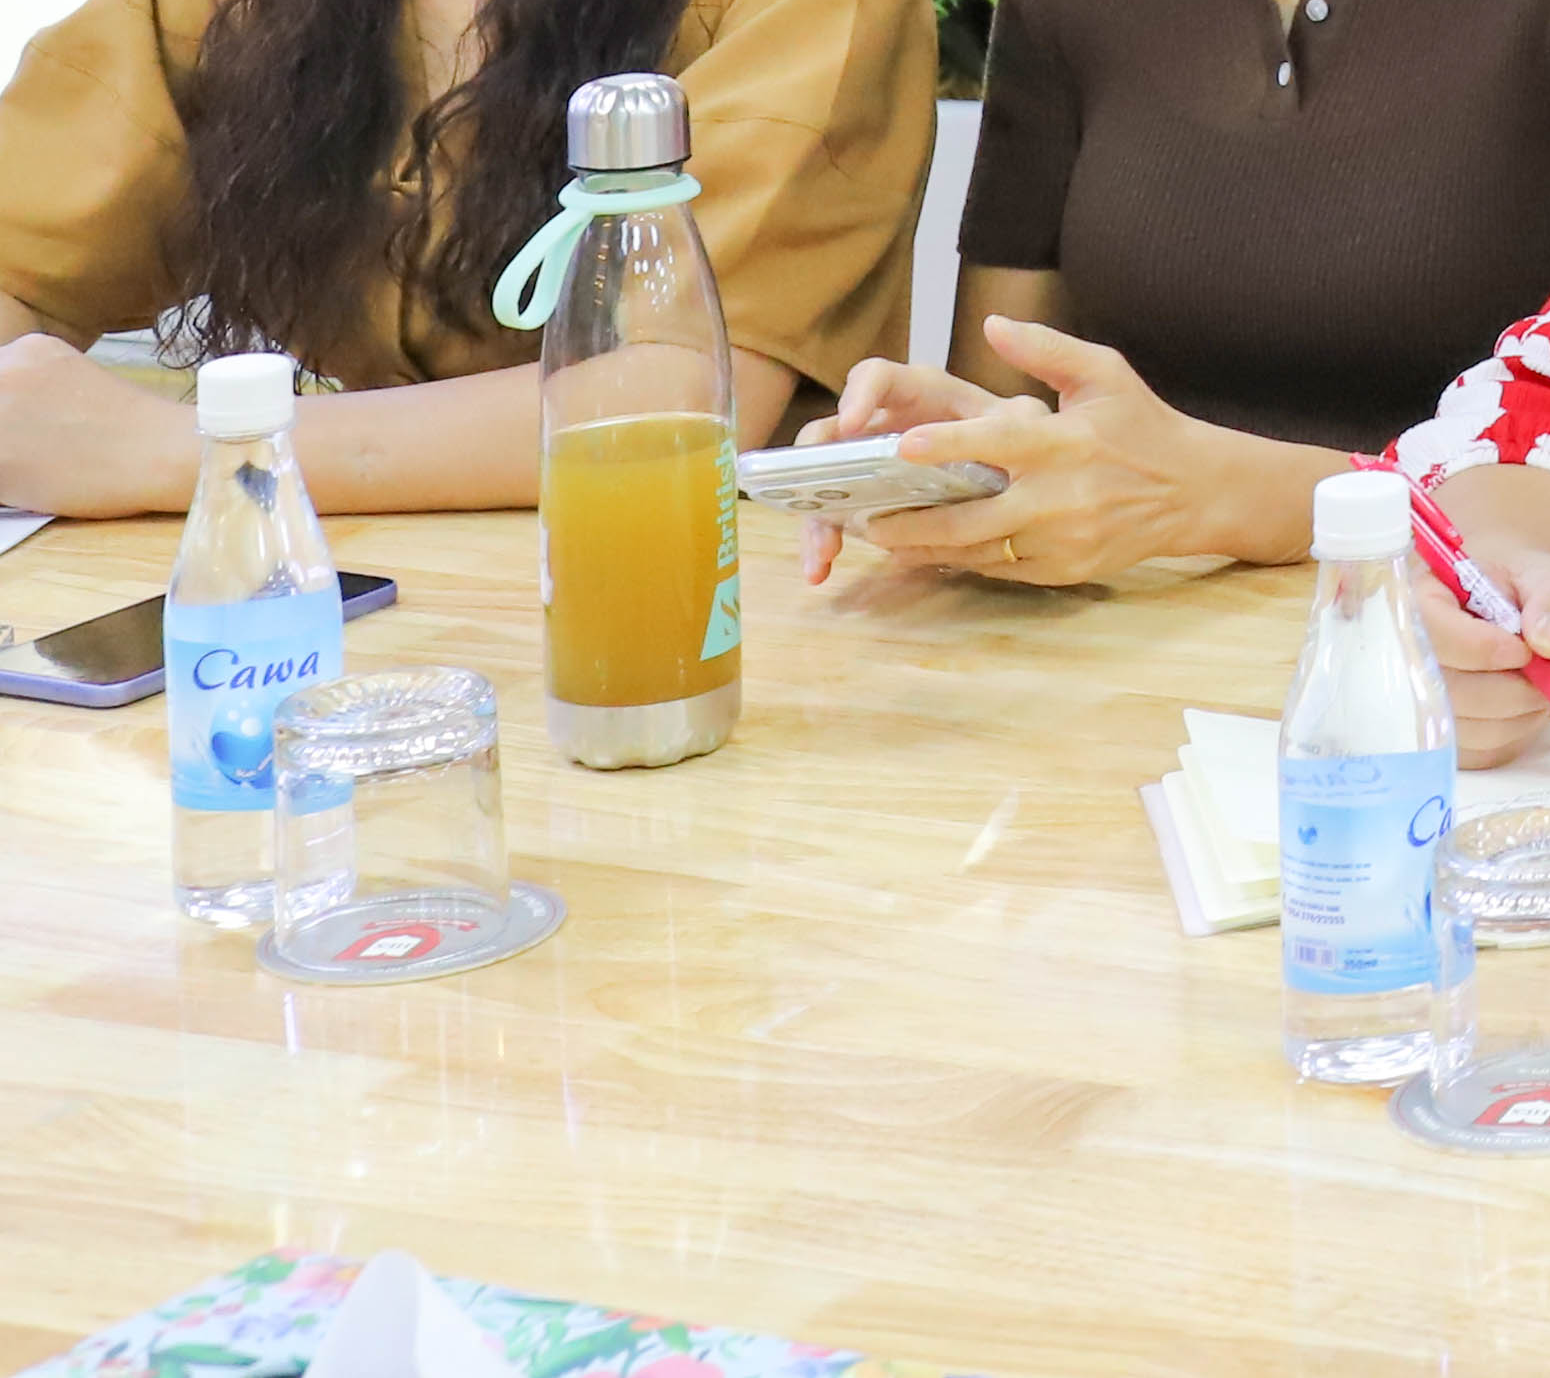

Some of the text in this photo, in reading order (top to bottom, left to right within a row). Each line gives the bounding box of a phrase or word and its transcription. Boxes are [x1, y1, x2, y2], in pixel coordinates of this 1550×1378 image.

[715, 439, 739, 571] British
[193, 648, 319, 690] Cawa
[1407, 795, 1453, 847] Ca
